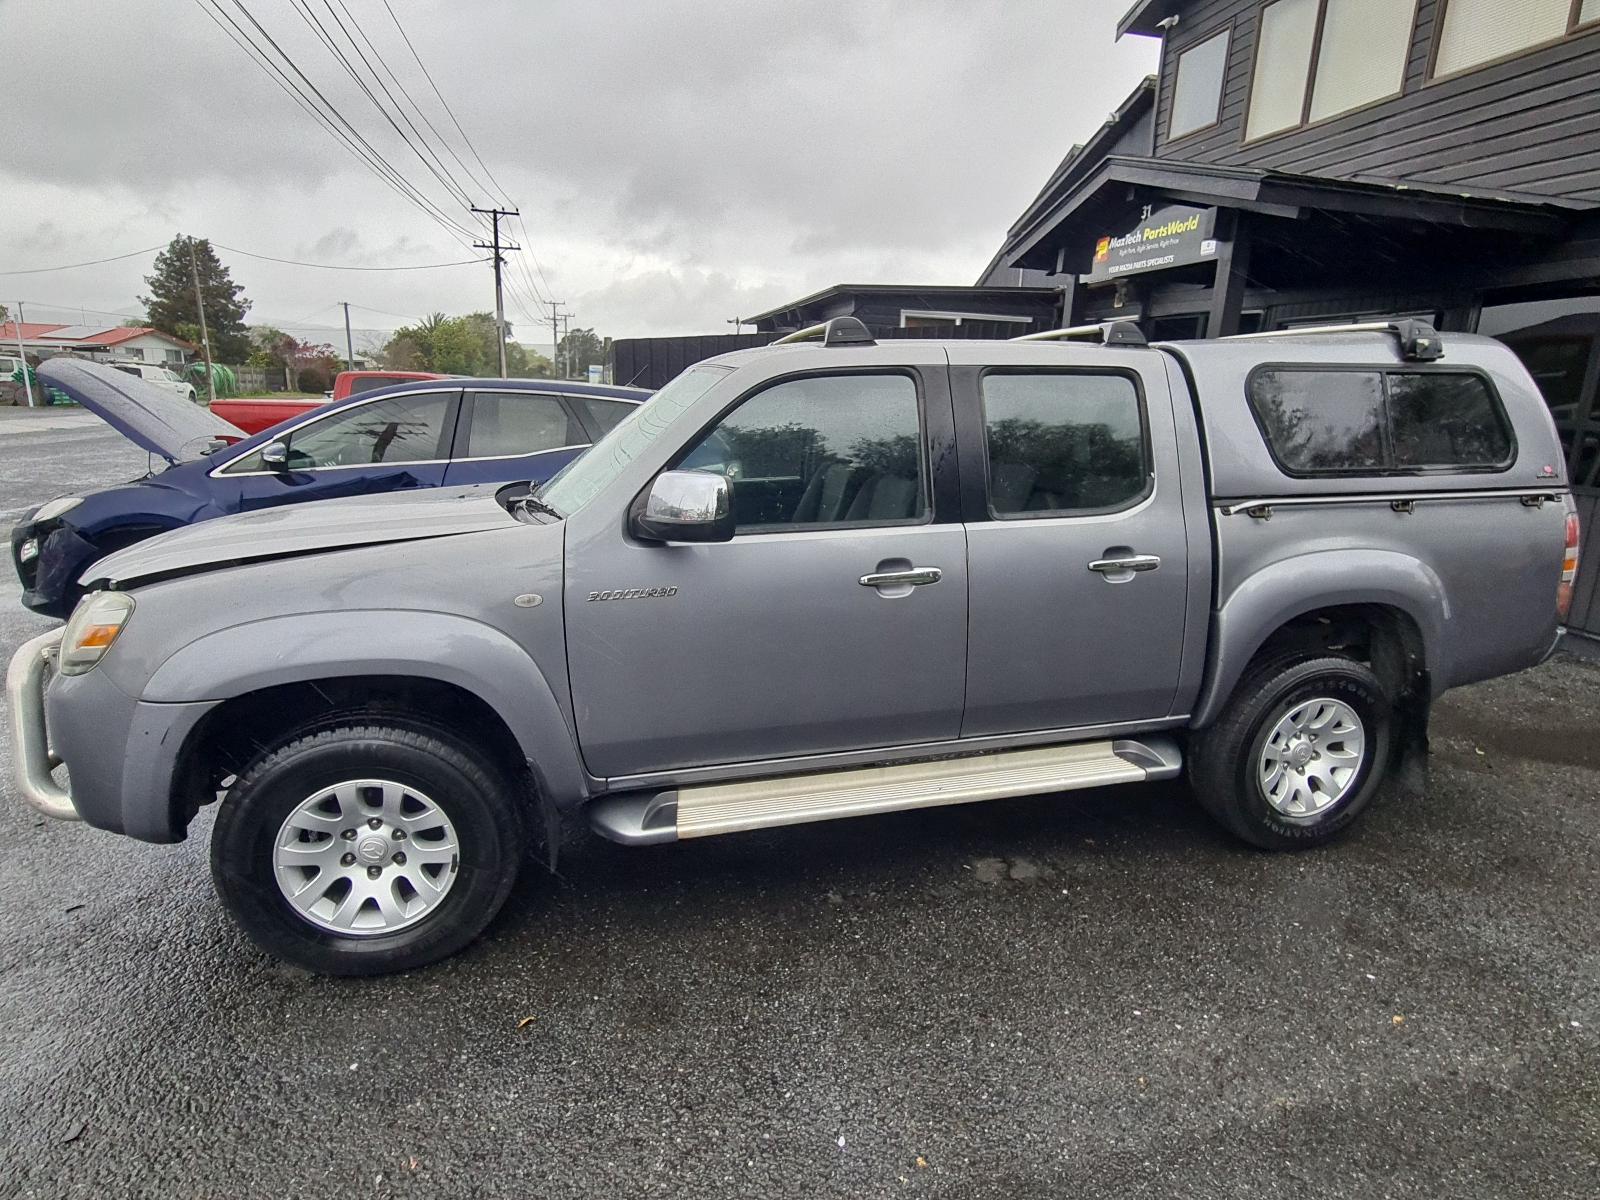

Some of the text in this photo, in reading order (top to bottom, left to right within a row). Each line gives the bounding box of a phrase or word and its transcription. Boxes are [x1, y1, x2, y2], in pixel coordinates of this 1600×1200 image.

[1141, 204, 1151, 219] 31
[1109, 214, 1200, 249] MazTech PartsWorld
[1147, 255, 1174, 267] SPECIALISTS
